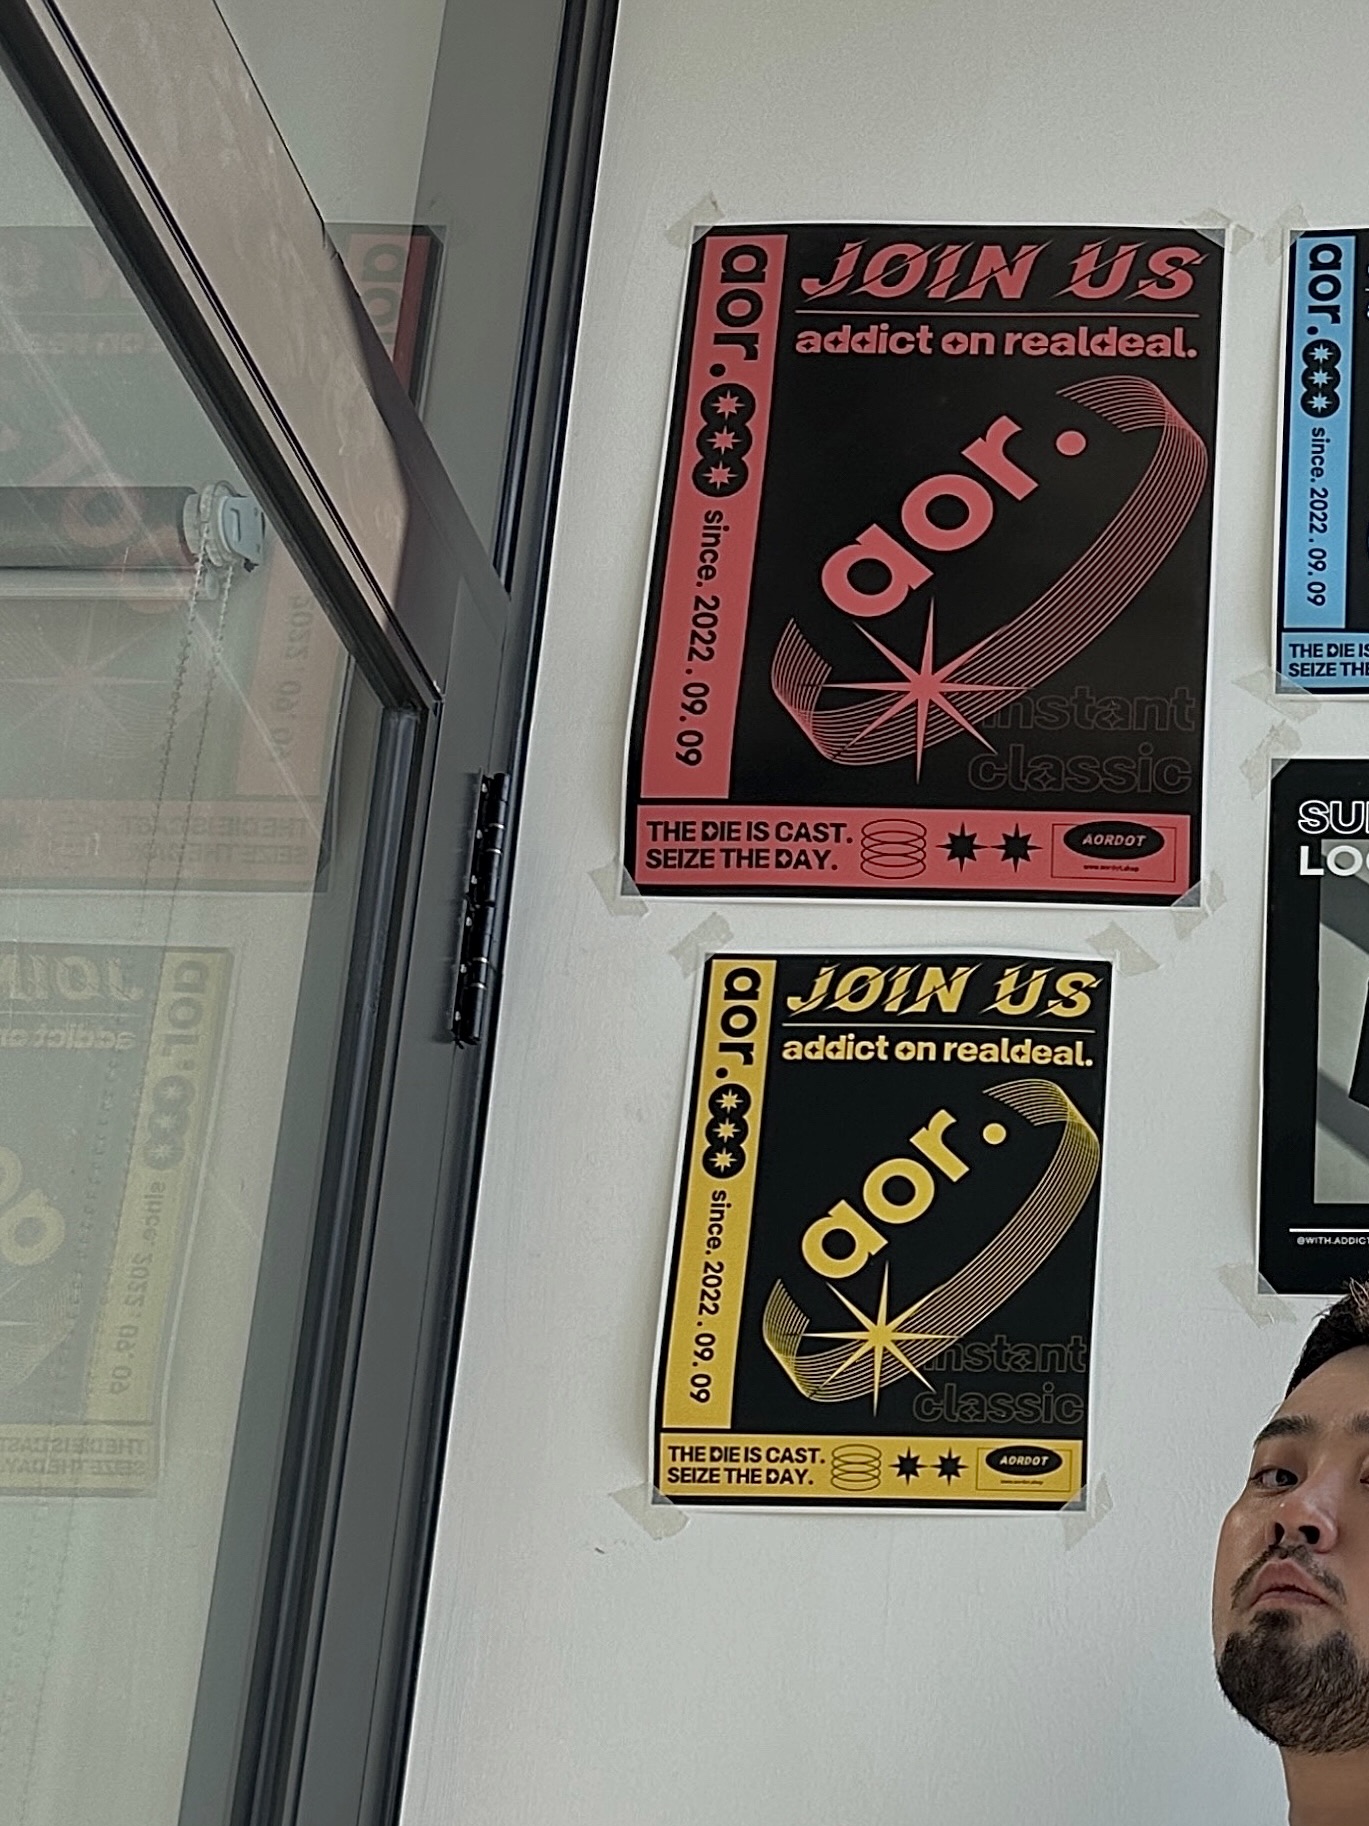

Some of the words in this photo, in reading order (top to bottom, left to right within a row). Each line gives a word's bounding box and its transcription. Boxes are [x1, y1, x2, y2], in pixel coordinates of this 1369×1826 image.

[800, 240, 1053, 301] JOIN
[1053, 244, 1209, 301] US
[796, 324, 933, 355] addict
[942, 329, 995, 356] on
[1005, 327, 1197, 359] realdeal.
[1310, 427, 1325, 482] since.
[696, 509, 730, 588] since.
[1289, 644, 1322, 659] THE
[1327, 644, 1357, 659] DIE
[1289, 662, 1337, 676] SEIZE
[968, 743, 1192, 793] classic
[646, 820, 697, 841] THE
[701, 820, 743, 842] DIE
[746, 820, 770, 842] IS
[774, 821, 853, 844] CAST.
[1083, 831, 1147, 850] AORDOT
[646, 848, 719, 869] SEIZE
[722, 848, 771, 869] THE
[774, 850, 838, 870] DAY.
[787, 963, 980, 1017] JOIN
[978, 964, 1104, 1019] US
[783, 1034, 889, 1061] addict
[896, 1040, 936, 1062] on
[944, 1038, 1094, 1066] realdeal.
[704, 1189, 731, 1254] since.
[914, 1382, 1084, 1425] classic
[668, 1446, 707, 1462] THE
[710, 1446, 742, 1463] DIE
[743, 1446, 763, 1463] IS
[766, 1447, 825, 1464] CAST.
[668, 1467, 721, 1484] SEIZE
[725, 1468, 763, 1485] THE
[766, 1468, 813, 1485] DAY.
